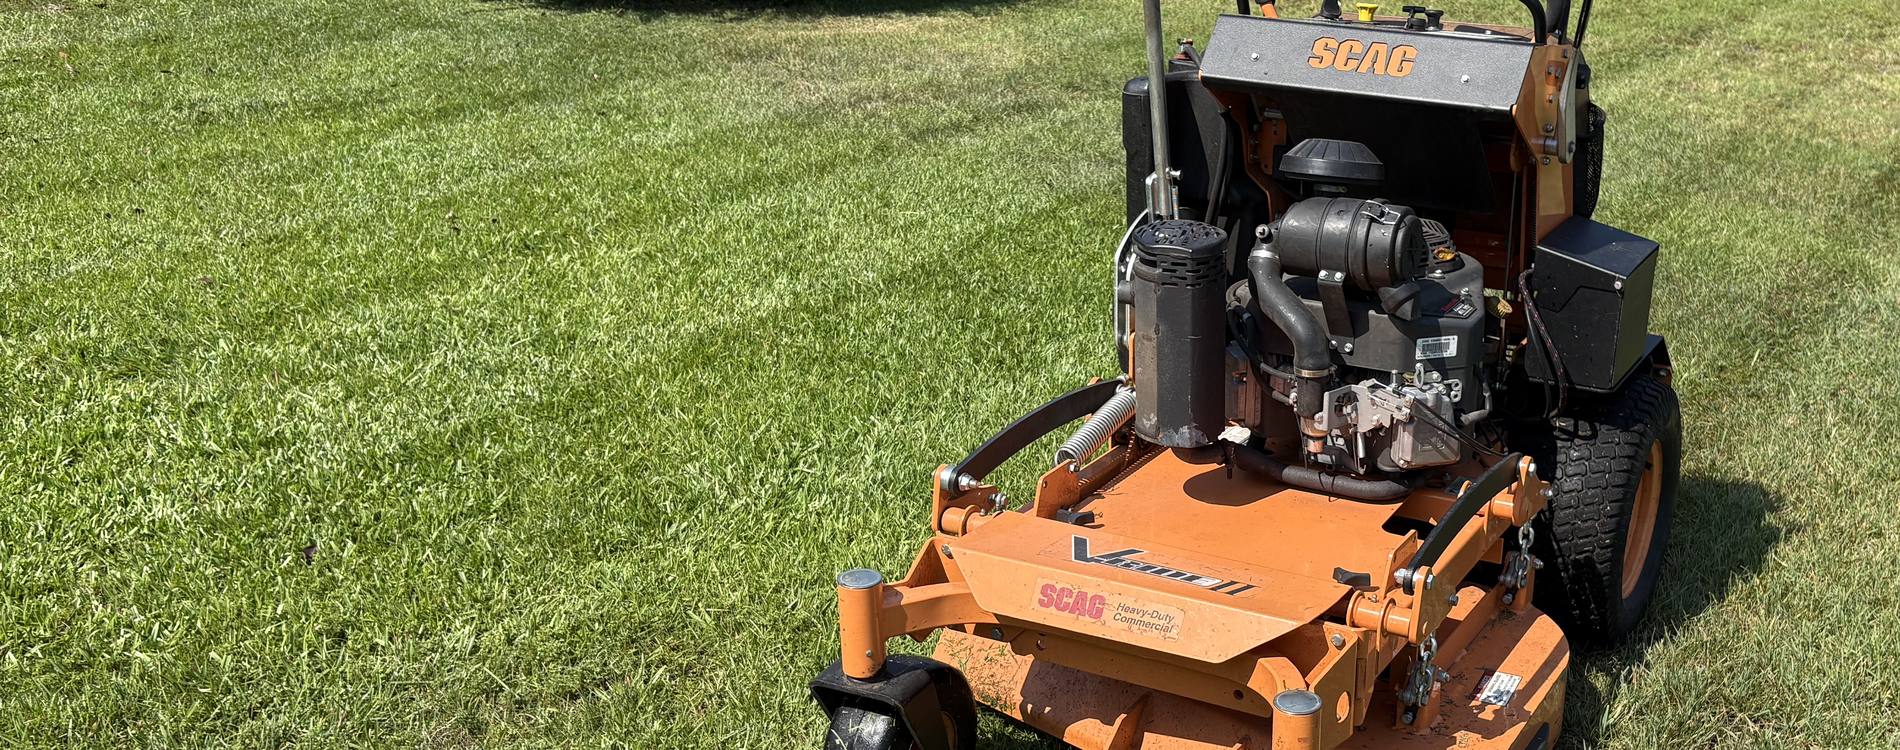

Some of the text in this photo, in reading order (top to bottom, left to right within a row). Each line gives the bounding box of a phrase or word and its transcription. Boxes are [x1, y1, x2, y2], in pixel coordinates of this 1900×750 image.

[1307, 36, 1419, 77] SCAG
[1038, 583, 1106, 620] SCAG
[1116, 602, 1175, 625] Heavy-Duty
[1113, 612, 1174, 634] Commercial
